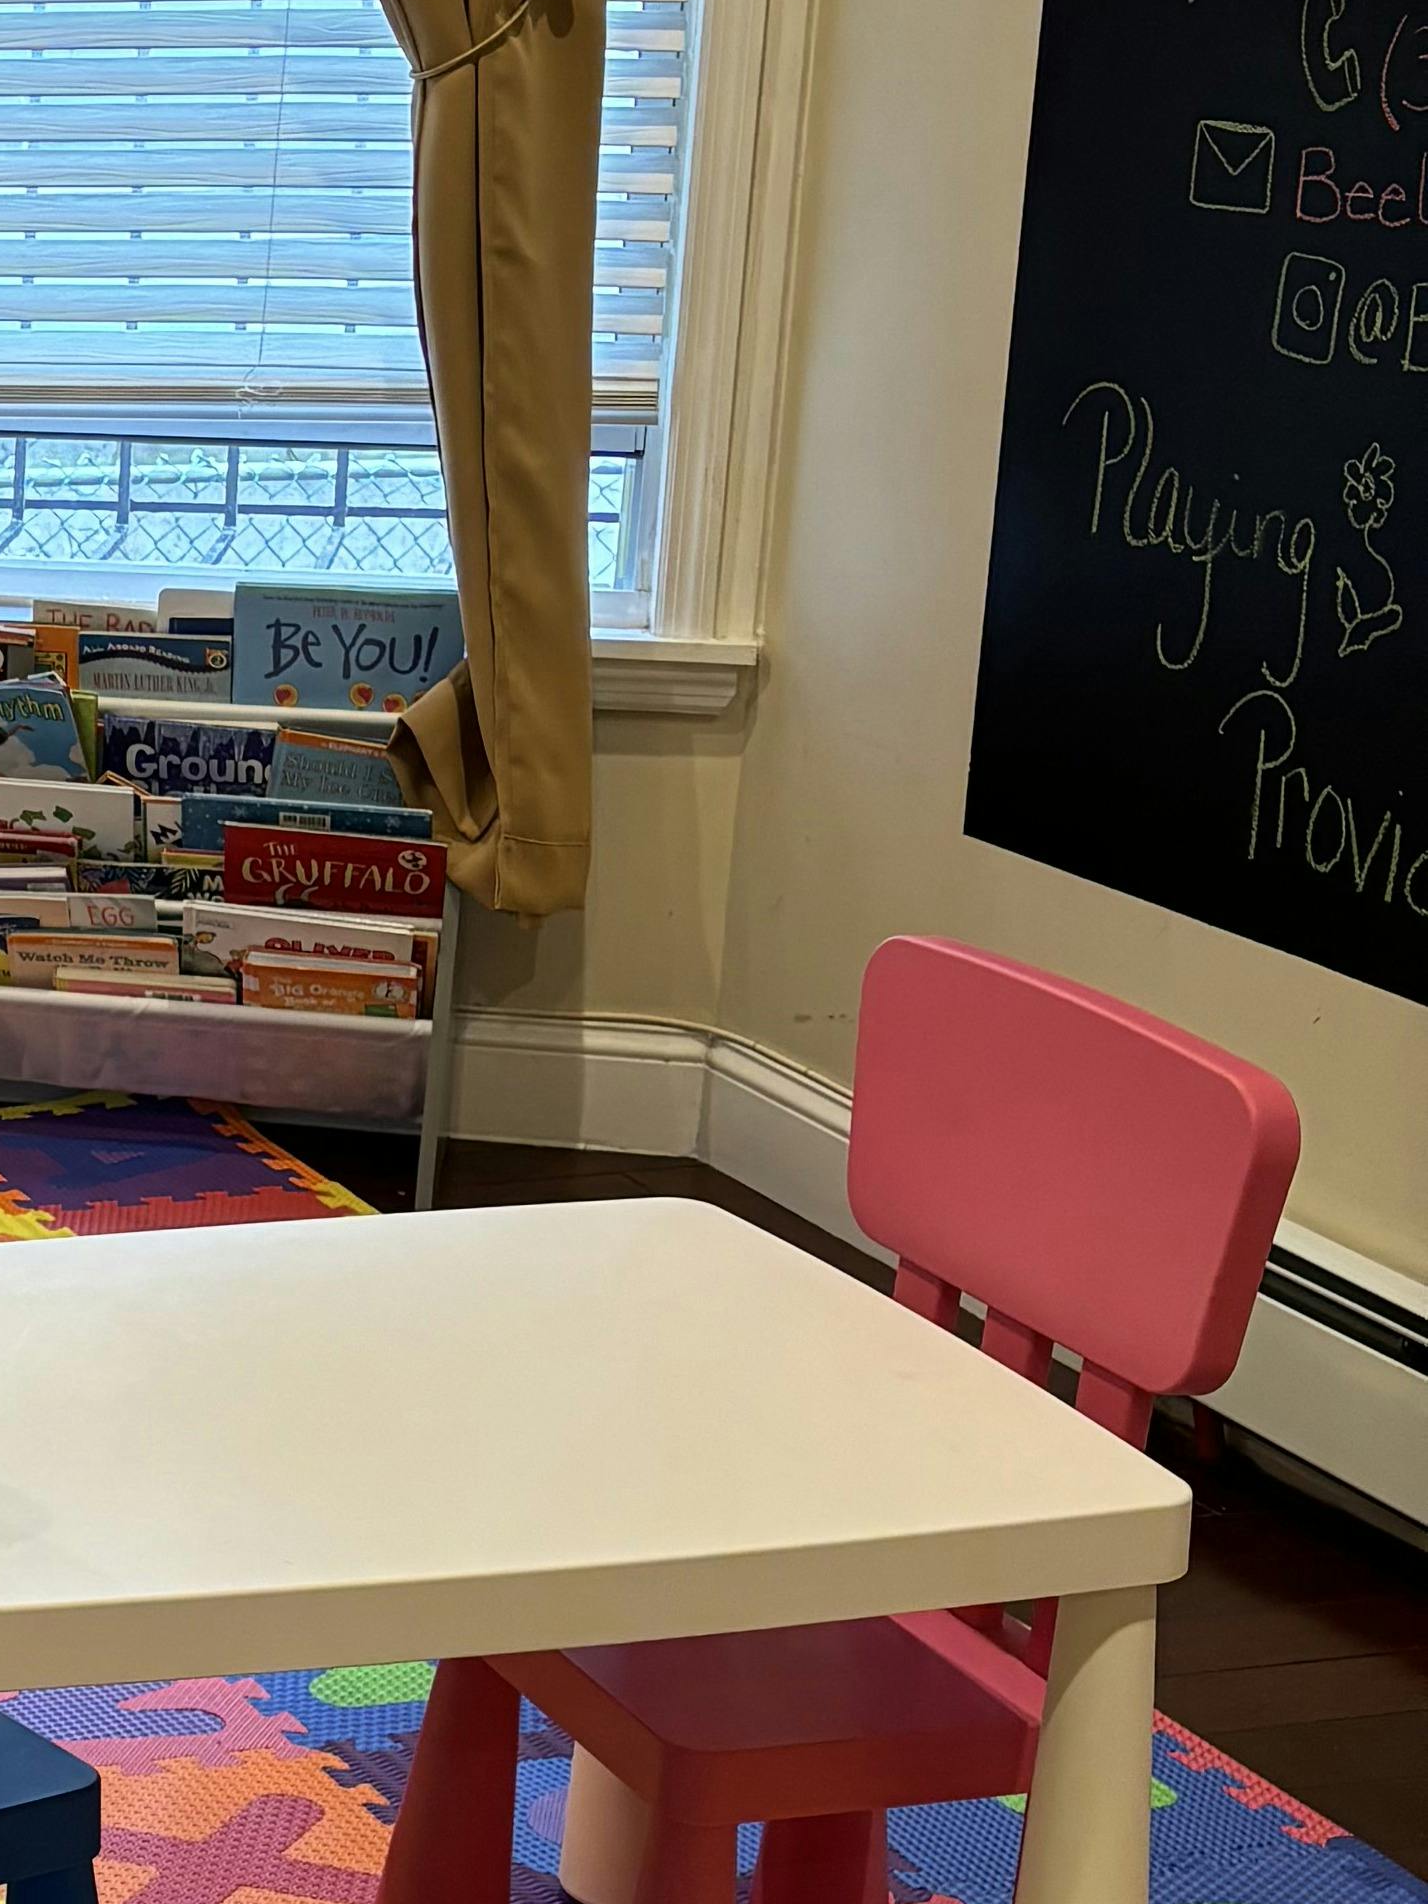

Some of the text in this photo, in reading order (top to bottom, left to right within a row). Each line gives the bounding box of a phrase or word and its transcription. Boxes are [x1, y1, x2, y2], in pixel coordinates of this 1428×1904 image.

[1062, 380, 1316, 689] Playing
[264, 617, 440, 683] Be YOU!
[92, 671, 130, 691] MARTIN
[134, 673, 173, 692] LUTHER
[125, 743, 271, 785] Groun
[284, 751, 358, 780] Should
[263, 841, 295, 856] THE
[242, 856, 431, 895] GRUFFALO
[87, 905, 135, 927] EGG
[17, 950, 74, 965] Watch
[79, 952, 105, 965] Me
[110, 954, 169, 969] Throw
